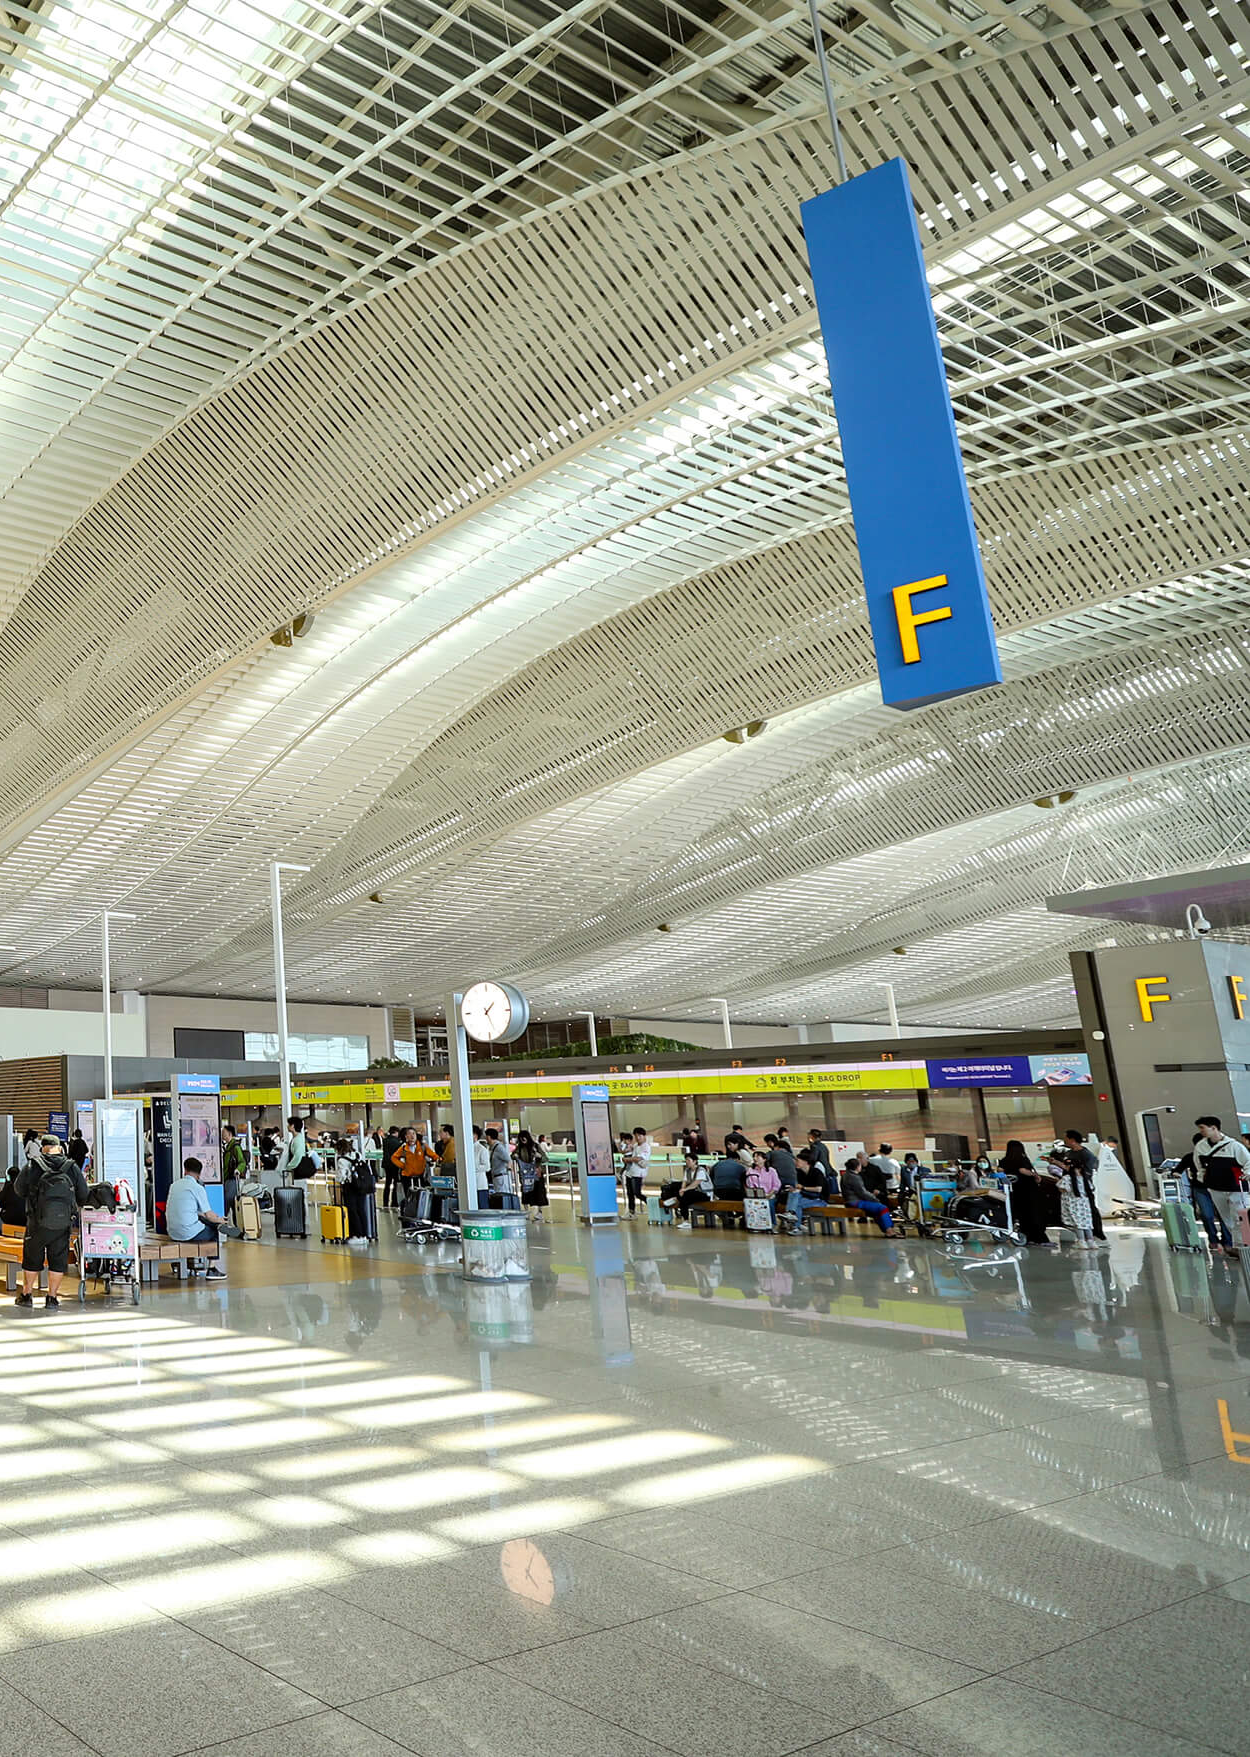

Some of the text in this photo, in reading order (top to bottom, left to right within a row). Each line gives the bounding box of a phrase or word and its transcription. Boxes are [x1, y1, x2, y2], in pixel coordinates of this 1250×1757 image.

[892, 574, 952, 664] F
[1135, 976, 1171, 1022] F
[1228, 975, 1248, 1020] F
[881, 1053, 893, 1062] F1
